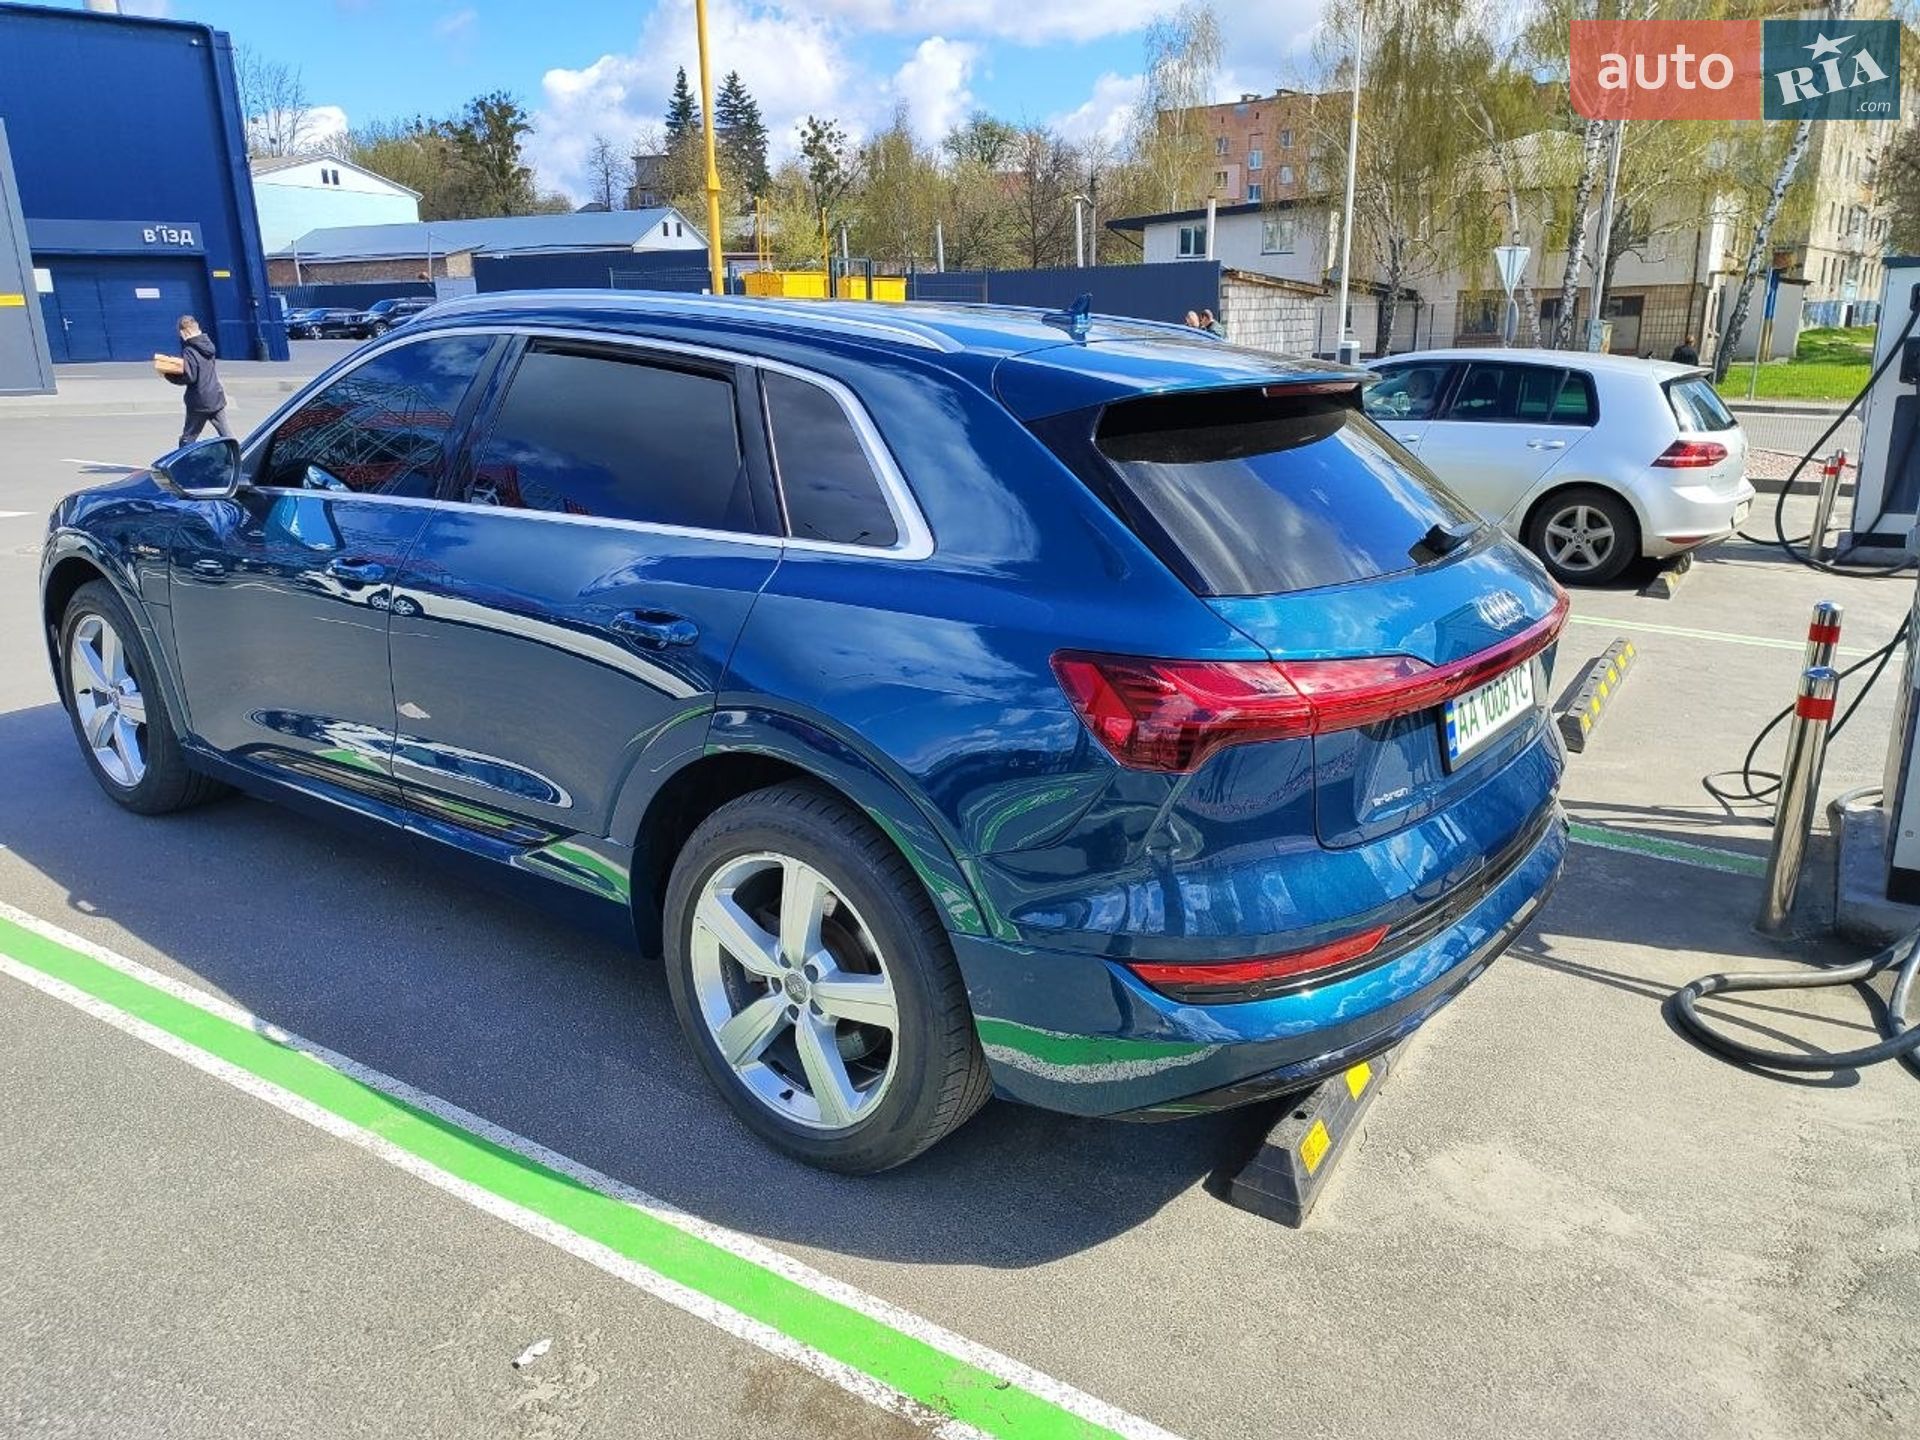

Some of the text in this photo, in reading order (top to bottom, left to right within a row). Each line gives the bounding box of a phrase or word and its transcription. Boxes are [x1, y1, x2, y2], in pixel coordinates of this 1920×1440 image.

[1458, 663, 1529, 744] AA 1008 YC
